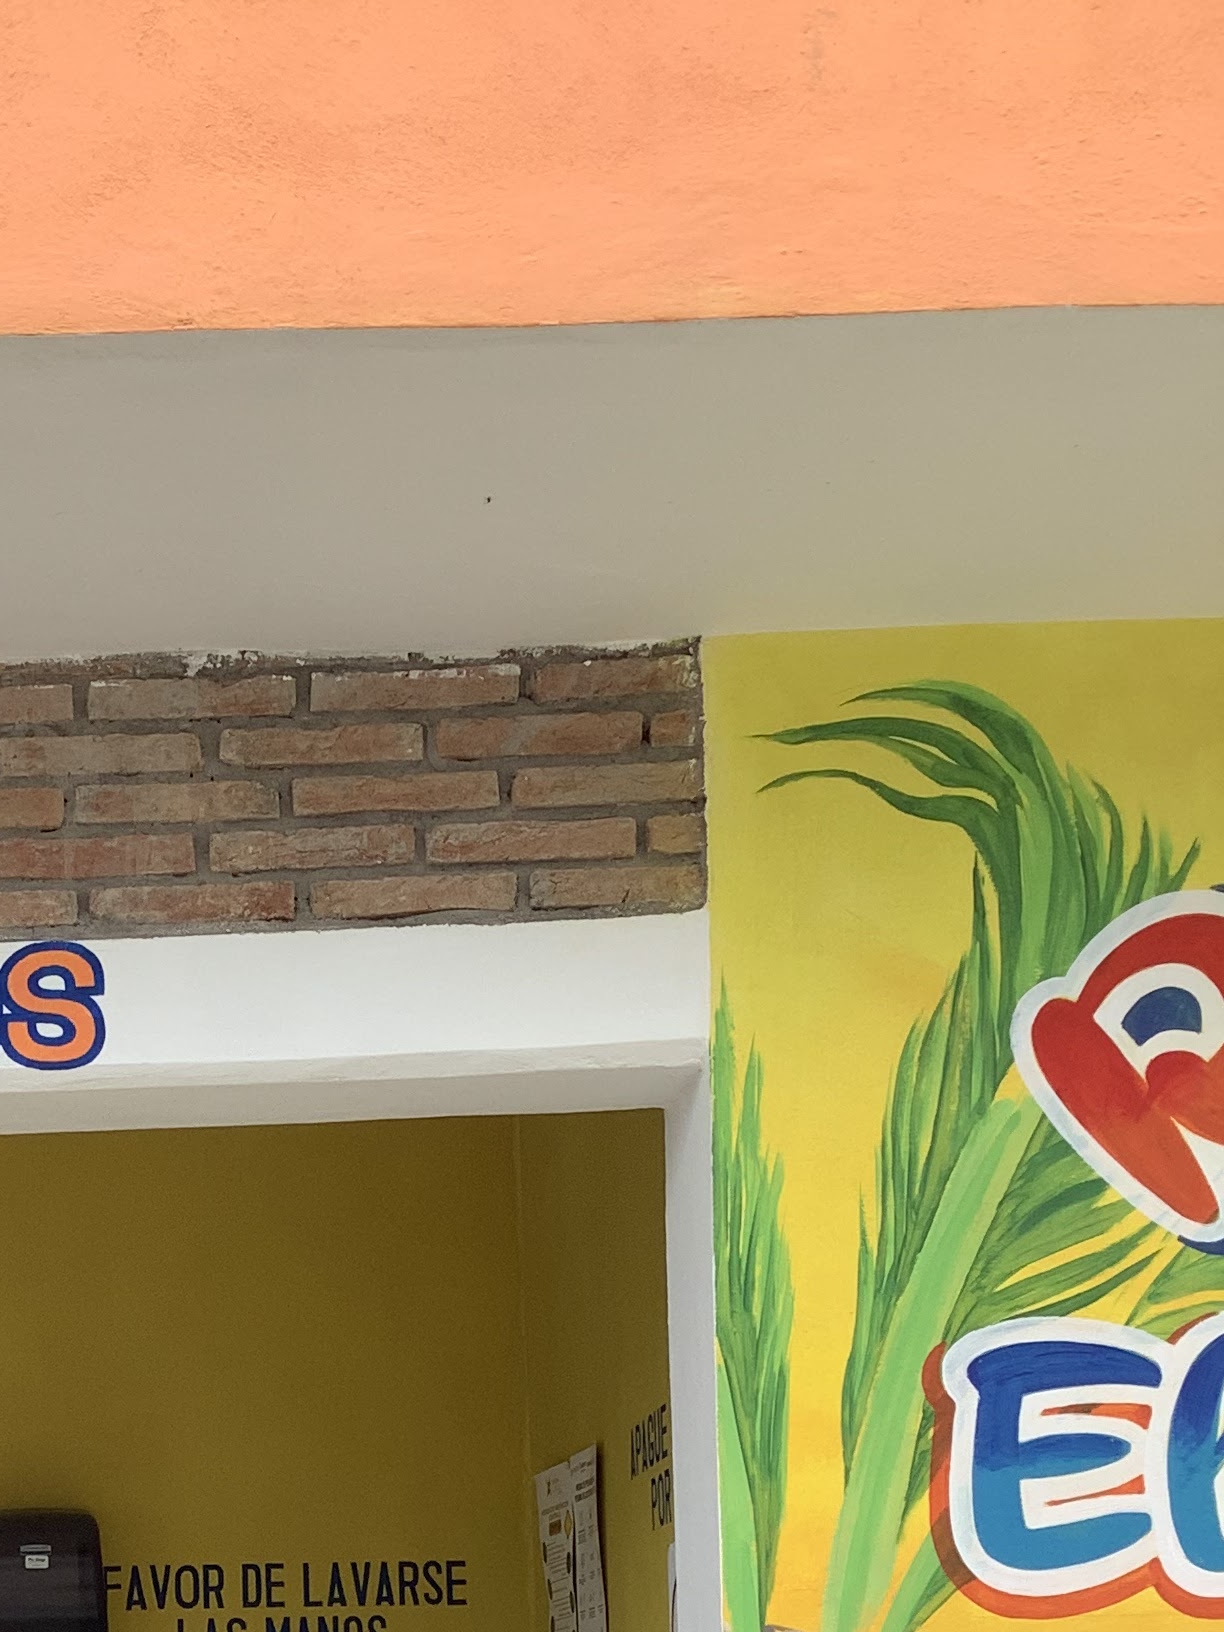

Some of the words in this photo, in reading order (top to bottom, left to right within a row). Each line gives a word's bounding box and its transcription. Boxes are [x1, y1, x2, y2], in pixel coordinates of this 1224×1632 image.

[630, 1403, 668, 1480] APAGUE
[651, 1468, 673, 1531] POR
[103, 1564, 224, 1611] FAVOR
[242, 1563, 285, 1609] DE
[302, 1560, 468, 1608] LAVARSE
